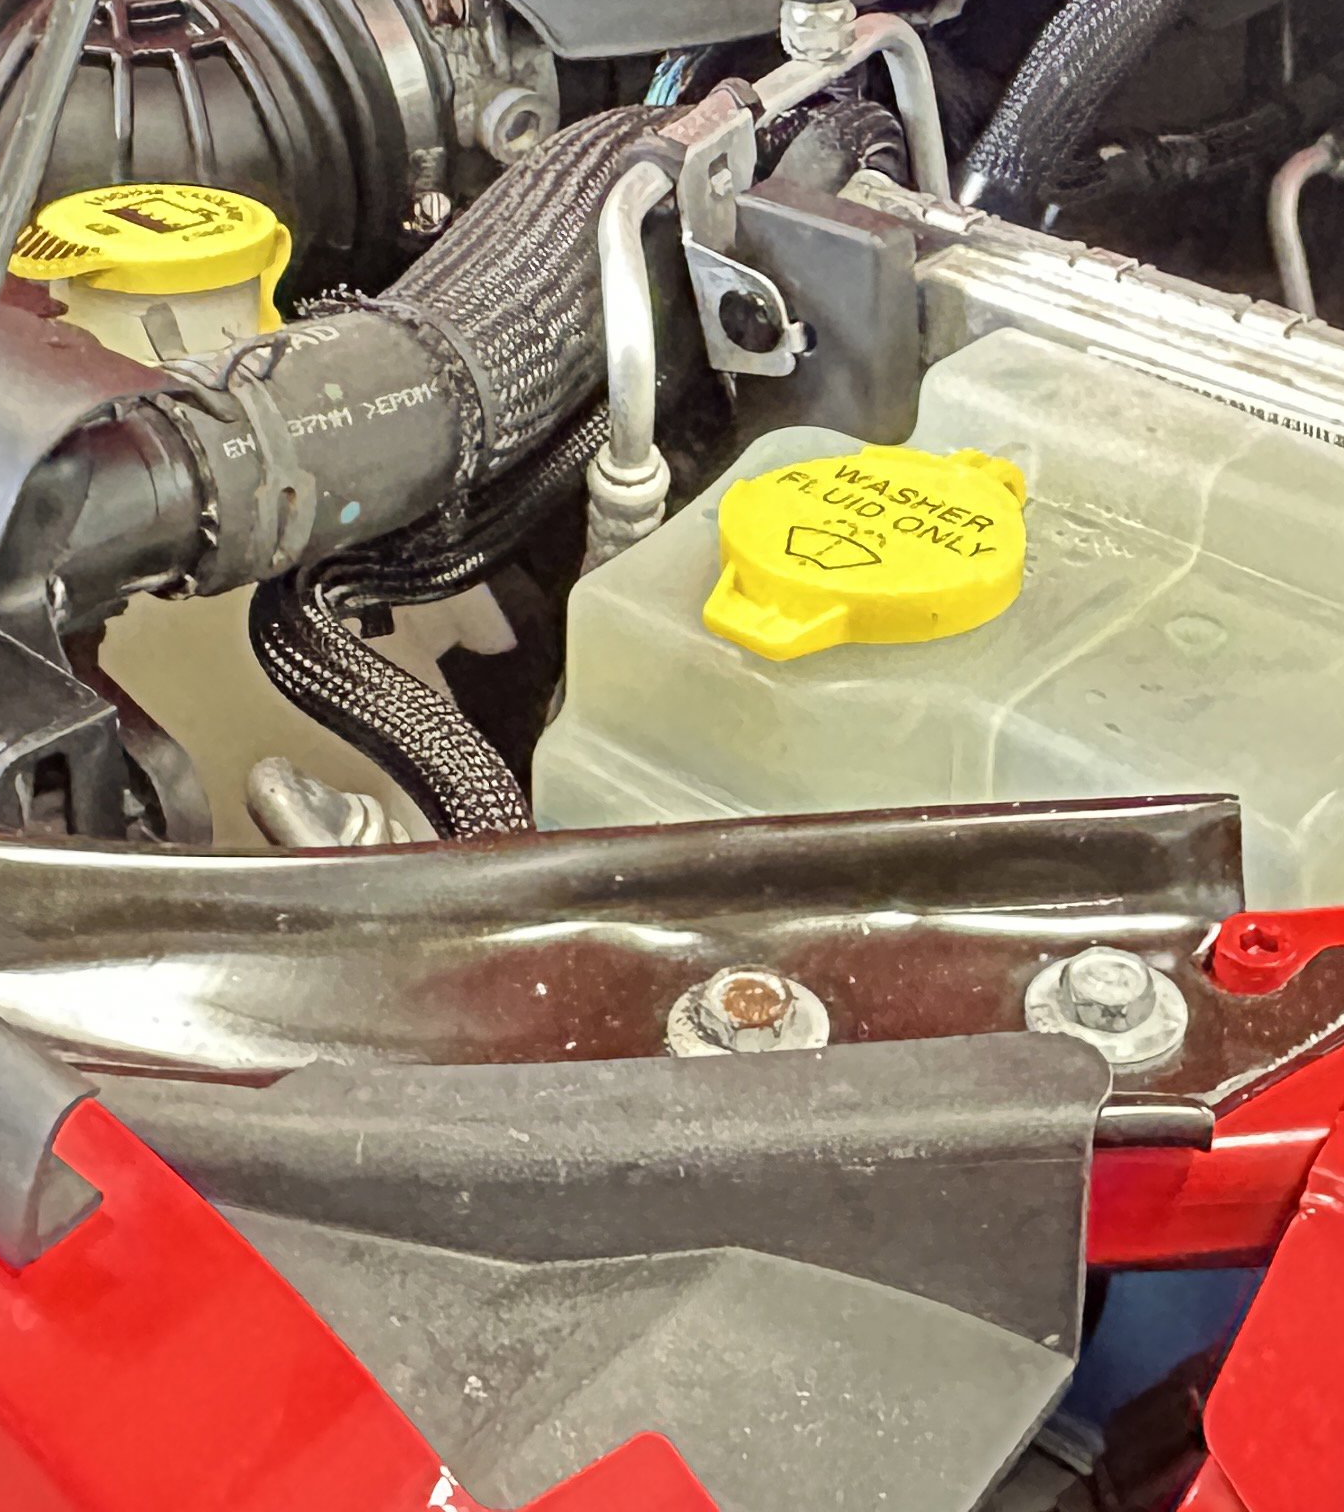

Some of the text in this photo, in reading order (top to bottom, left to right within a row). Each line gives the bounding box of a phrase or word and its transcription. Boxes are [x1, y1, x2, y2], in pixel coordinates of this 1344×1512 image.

[776, 470, 998, 558] FLUID ONLY
[833, 463, 999, 534] WASHER
